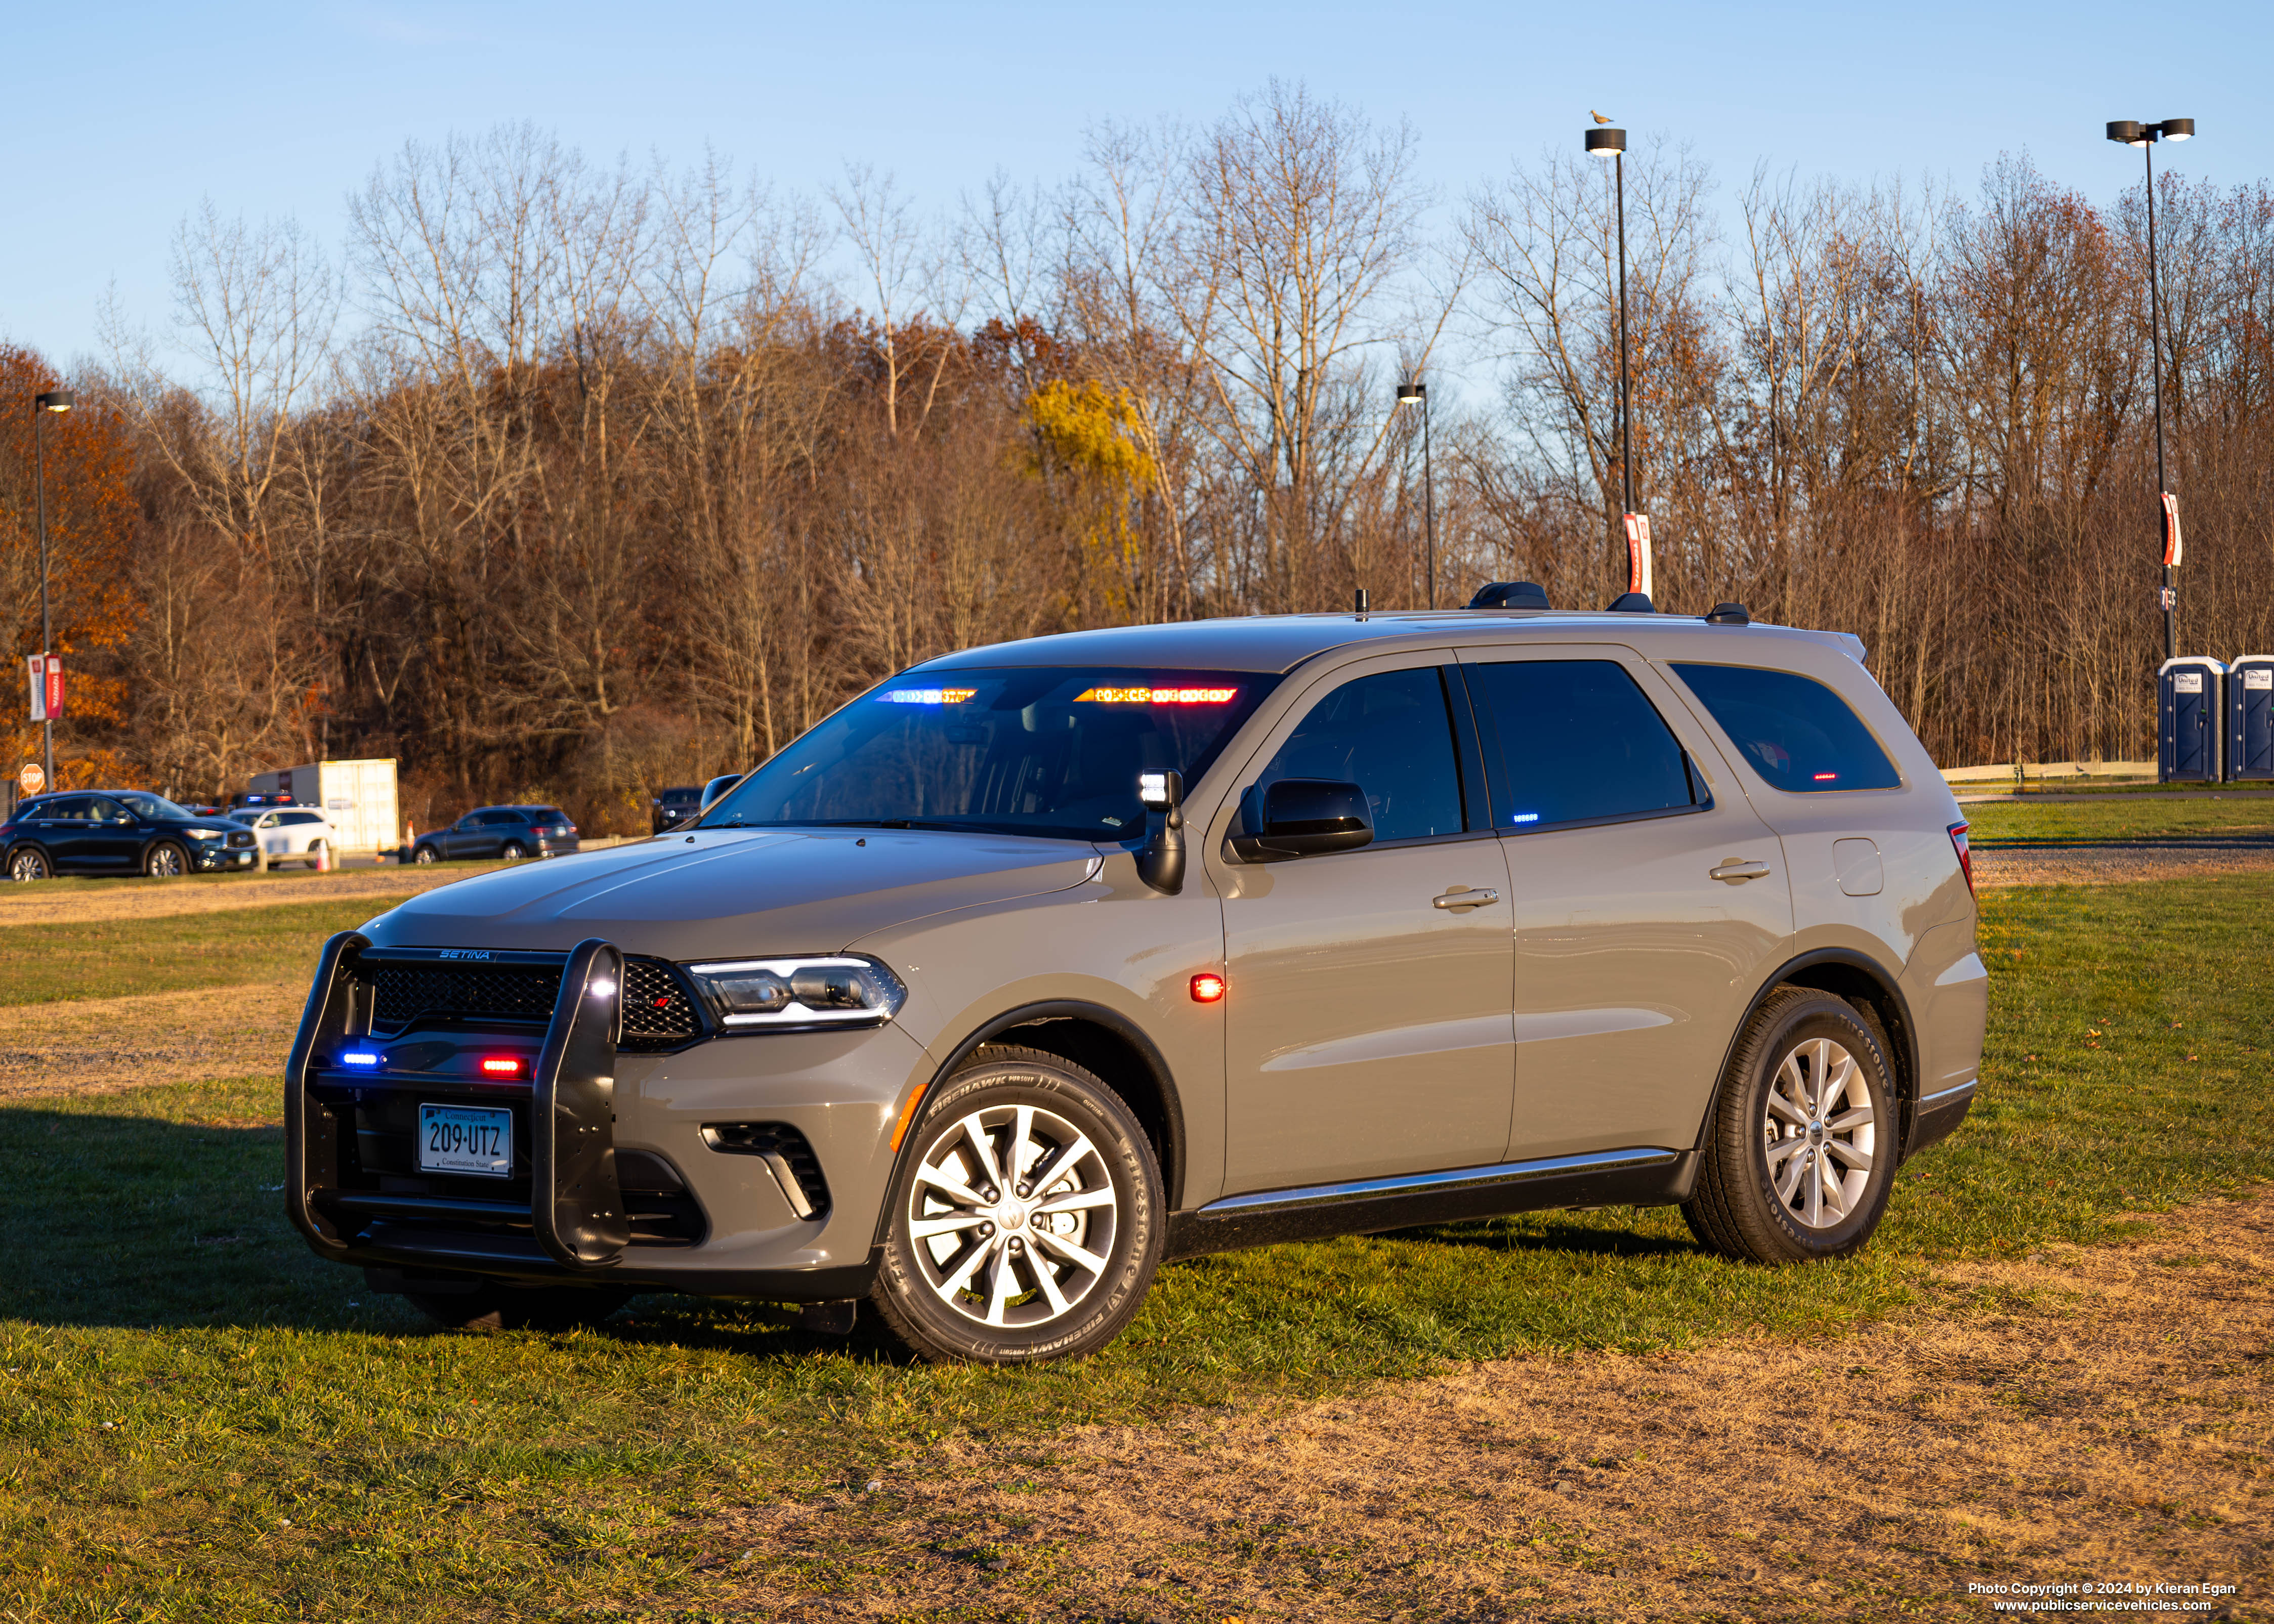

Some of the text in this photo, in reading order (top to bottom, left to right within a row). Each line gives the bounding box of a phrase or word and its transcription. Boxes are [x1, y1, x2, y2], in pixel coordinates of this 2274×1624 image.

[23, 773, 42, 784] STOP
[439, 950, 490, 960] SETINA
[1839, 1013, 1889, 1089] Firestone
[930, 1076, 1007, 1118] FIREHAWK
[445, 1110, 486, 1122] Connecticut
[1083, 1098, 1104, 1117] OUTSIDE
[442, 1157, 475, 1167] Constitution
[1122, 1146, 1148, 1276] Firestone
[1027, 1312, 1105, 1355] FIREHAWK
